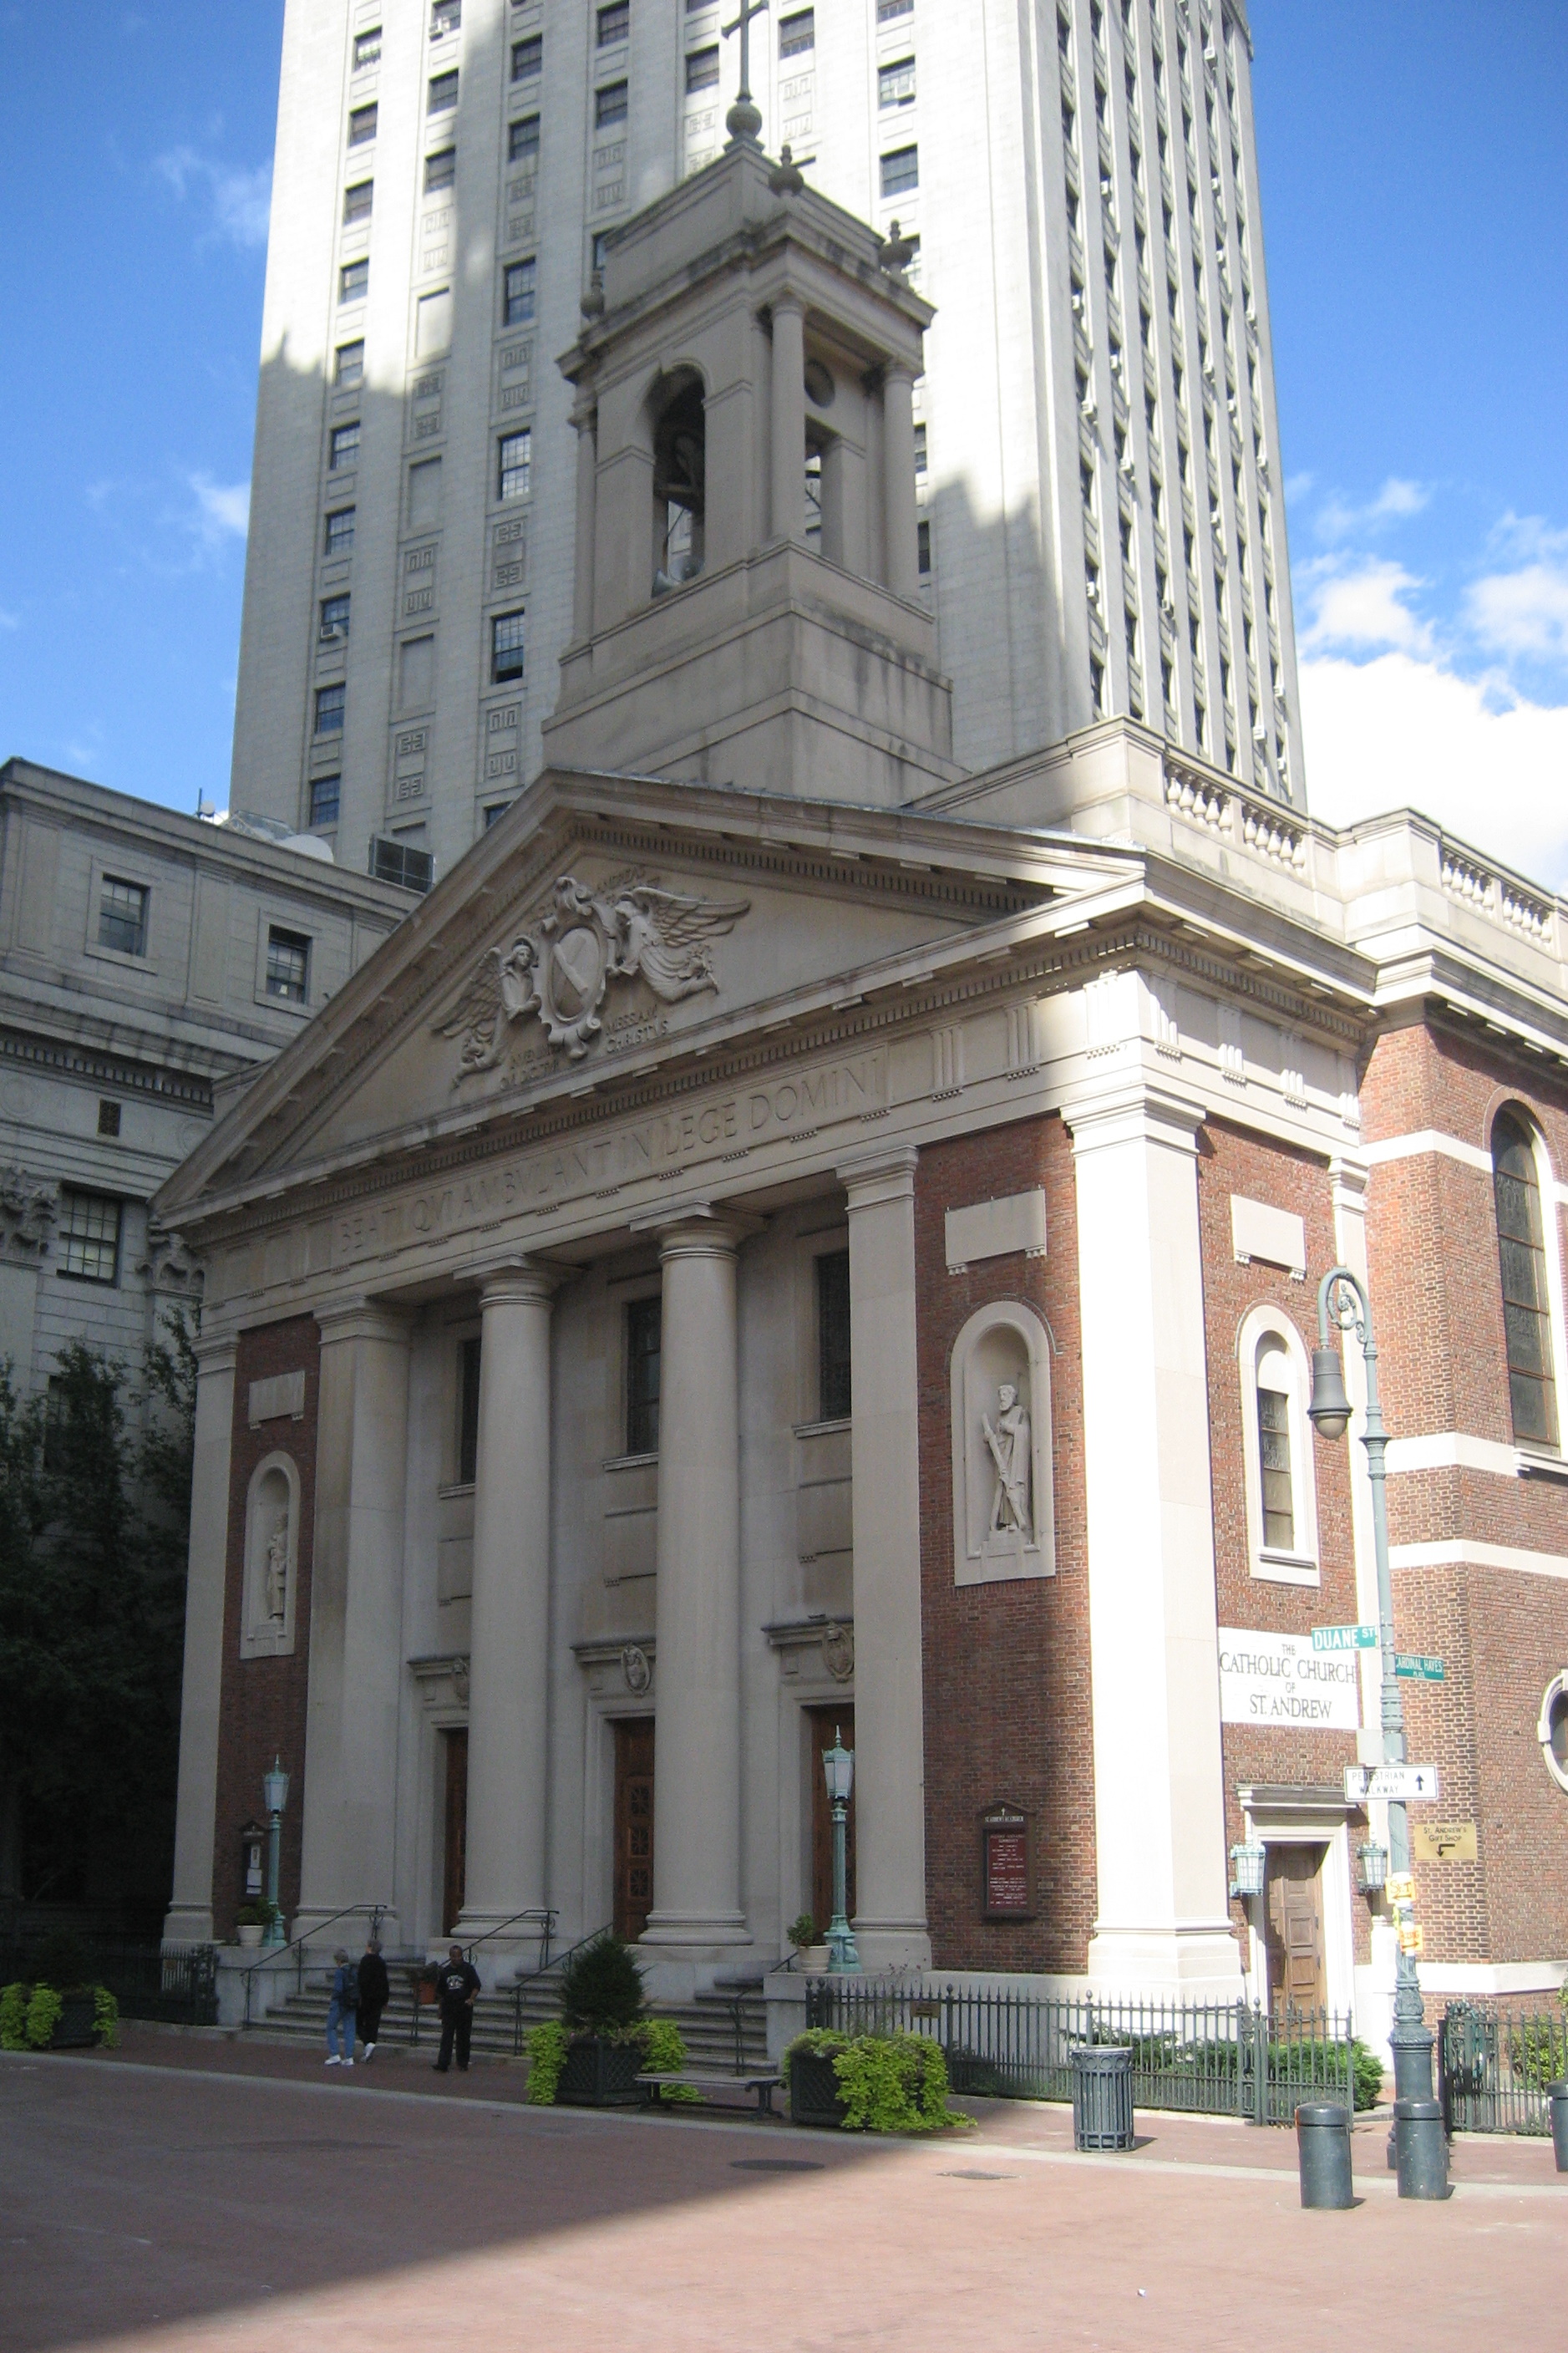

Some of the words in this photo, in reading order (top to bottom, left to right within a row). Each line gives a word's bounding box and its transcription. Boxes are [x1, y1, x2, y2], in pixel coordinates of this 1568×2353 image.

[662, 1102, 738, 1156] LEGE
[748, 1057, 880, 1132] DOMINI
[1314, 1629, 1359, 1649] DUANE
[1362, 1628, 1374, 1639] ST
[1281, 1644, 1296, 1655] THE
[1220, 1652, 1291, 1678] CATHOLIC
[1297, 1659, 1357, 1683] CHURCH
[1423, 1659, 1443, 1672] HAYES
[1286, 1682, 1296, 1693] OF
[1250, 1694, 1266, 1715] ST.
[1270, 1696, 1332, 1719] ANDREW
[1352, 1771, 1405, 1781] PEDESTRIAN
[1359, 1785, 1398, 1795] WALKWAY
